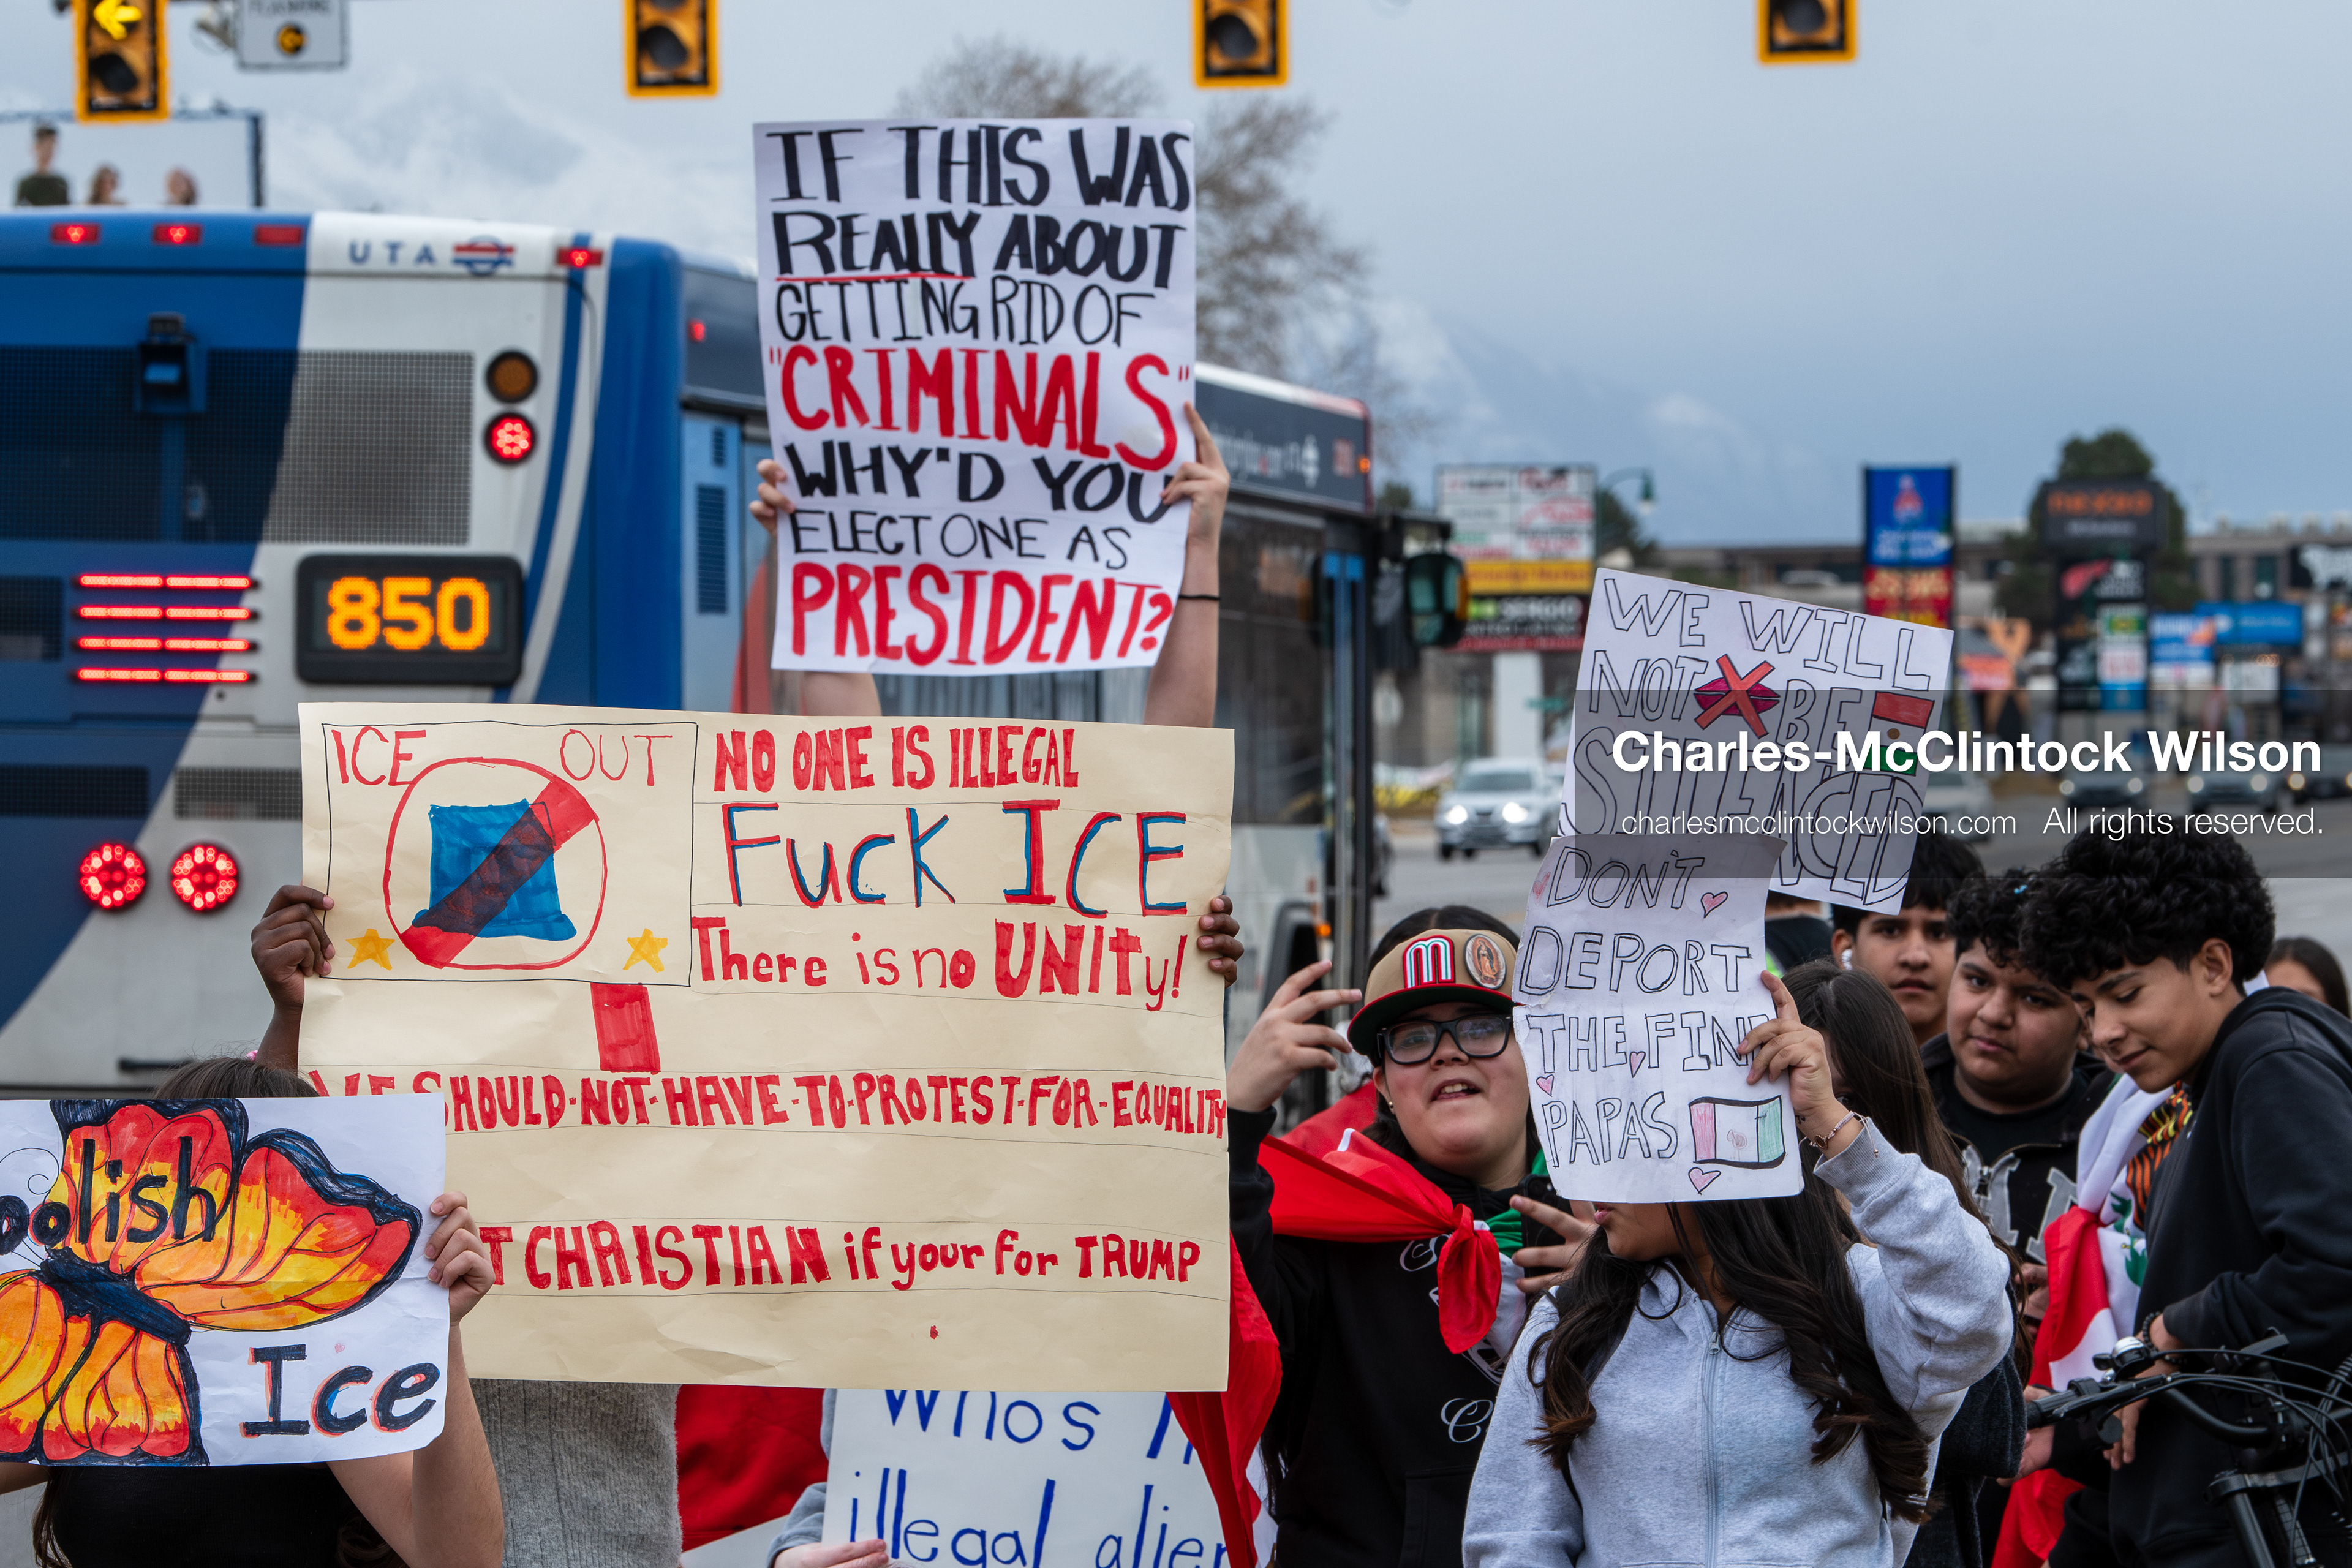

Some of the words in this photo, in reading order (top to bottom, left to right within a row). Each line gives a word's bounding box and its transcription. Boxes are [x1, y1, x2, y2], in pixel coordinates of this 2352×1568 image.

[766, 128, 864, 203] IF
[887, 125, 1050, 206] THIS
[1069, 126, 1190, 212] WAS
[347, 243, 438, 266] UTA
[772, 210, 981, 278] REALLY
[993, 213, 1187, 289] ABOUT
[775, 277, 979, 343] GETTING
[990, 275, 1065, 345] RID
[1073, 284, 1156, 347] OF
[769, 345, 1190, 471] "CRIMINALS"
[1033, 454, 1175, 524] YOU
[790, 509, 932, 556] ELECT
[940, 512, 1049, 560] ONE
[1066, 524, 1132, 570] AS
[328, 576, 490, 650] 850
[791, 561, 1174, 667] PRESIDENT?
[1604, 578, 1709, 647] WE
[1740, 601, 1931, 691] WILL
[1589, 650, 1709, 721] NOT
[1776, 679, 1863, 767] BE
[331, 726, 426, 786] ICE
[560, 729, 673, 786] OUT
[714, 729, 777, 793] NO
[792, 725, 875, 792] ONE
[891, 725, 936, 790] IS
[949, 725, 1079, 789] ILLEGAL
[1001, 799, 1188, 919] ICE
[690, 916, 827, 986] There
[851, 932, 900, 986] is
[911, 948, 976, 989] no
[1519, 925, 1754, 997] DEPORT
[1526, 1014, 1627, 1074] THE
[1541, 1091, 1679, 1168] PAPAS
[524, 1220, 832, 1291] CHRISTIAN
[843, 1226, 882, 1281] if
[890, 1241, 985, 1291] your
[995, 1229, 1059, 1276] for
[1074, 1232, 1201, 1283] TRUMP
[239, 1343, 440, 1438] Ice
